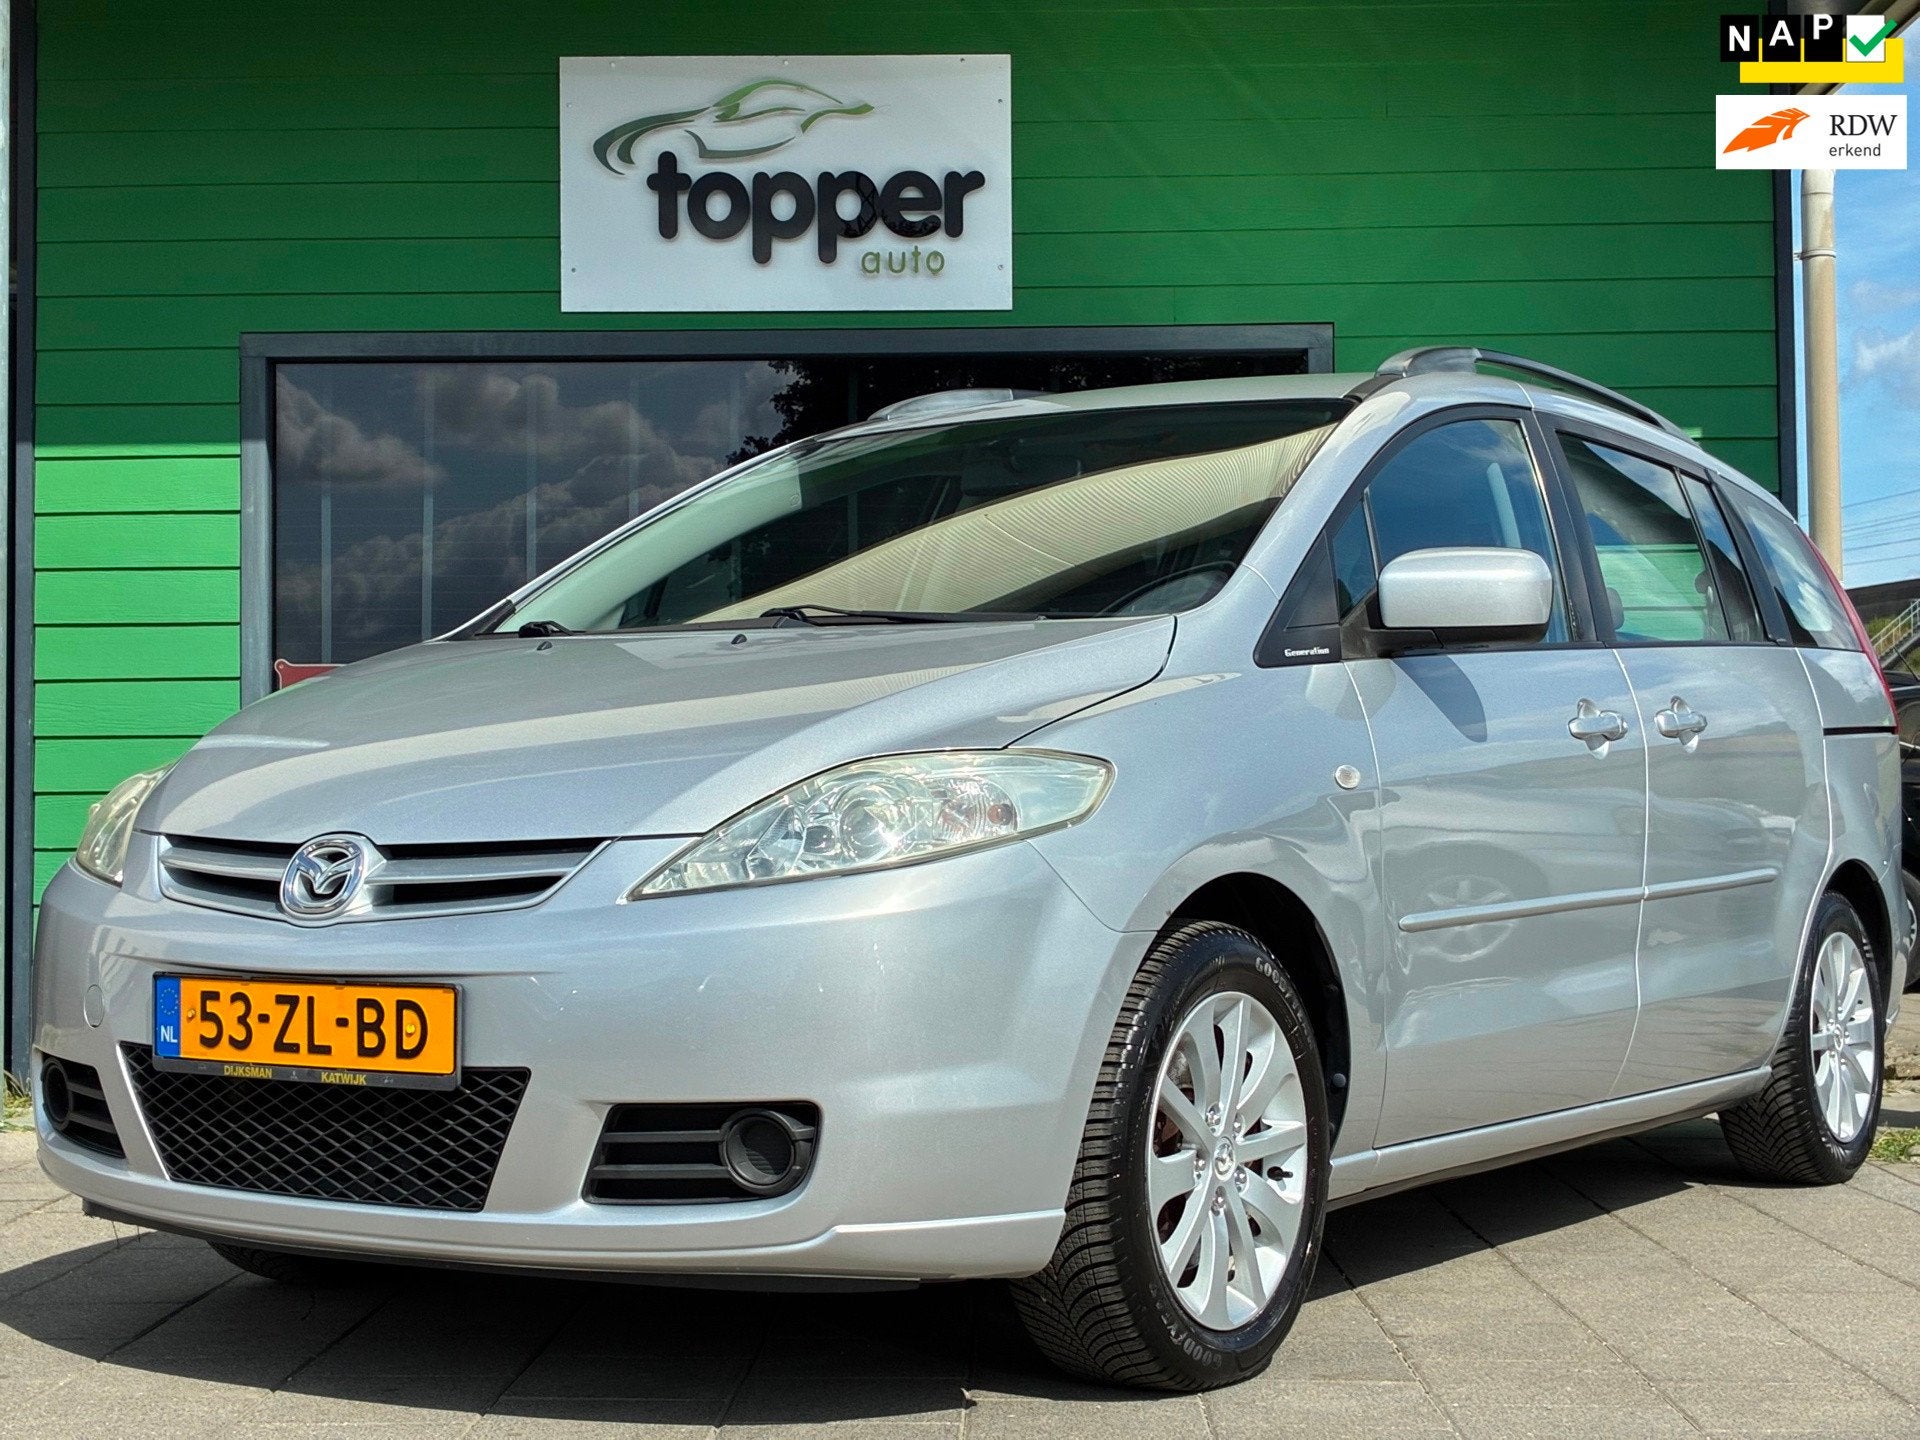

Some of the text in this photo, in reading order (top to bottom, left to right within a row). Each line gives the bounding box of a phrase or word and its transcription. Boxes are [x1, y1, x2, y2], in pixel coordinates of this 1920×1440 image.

[646, 150, 986, 265] topper
[860, 244, 946, 276] auto
[1283, 646, 1330, 658] Generation
[160, 1025, 179, 1044] NL
[199, 989, 429, 1060] 53-ZL-BD
[223, 1064, 368, 1087] DIJKSMAN KATWIJK
